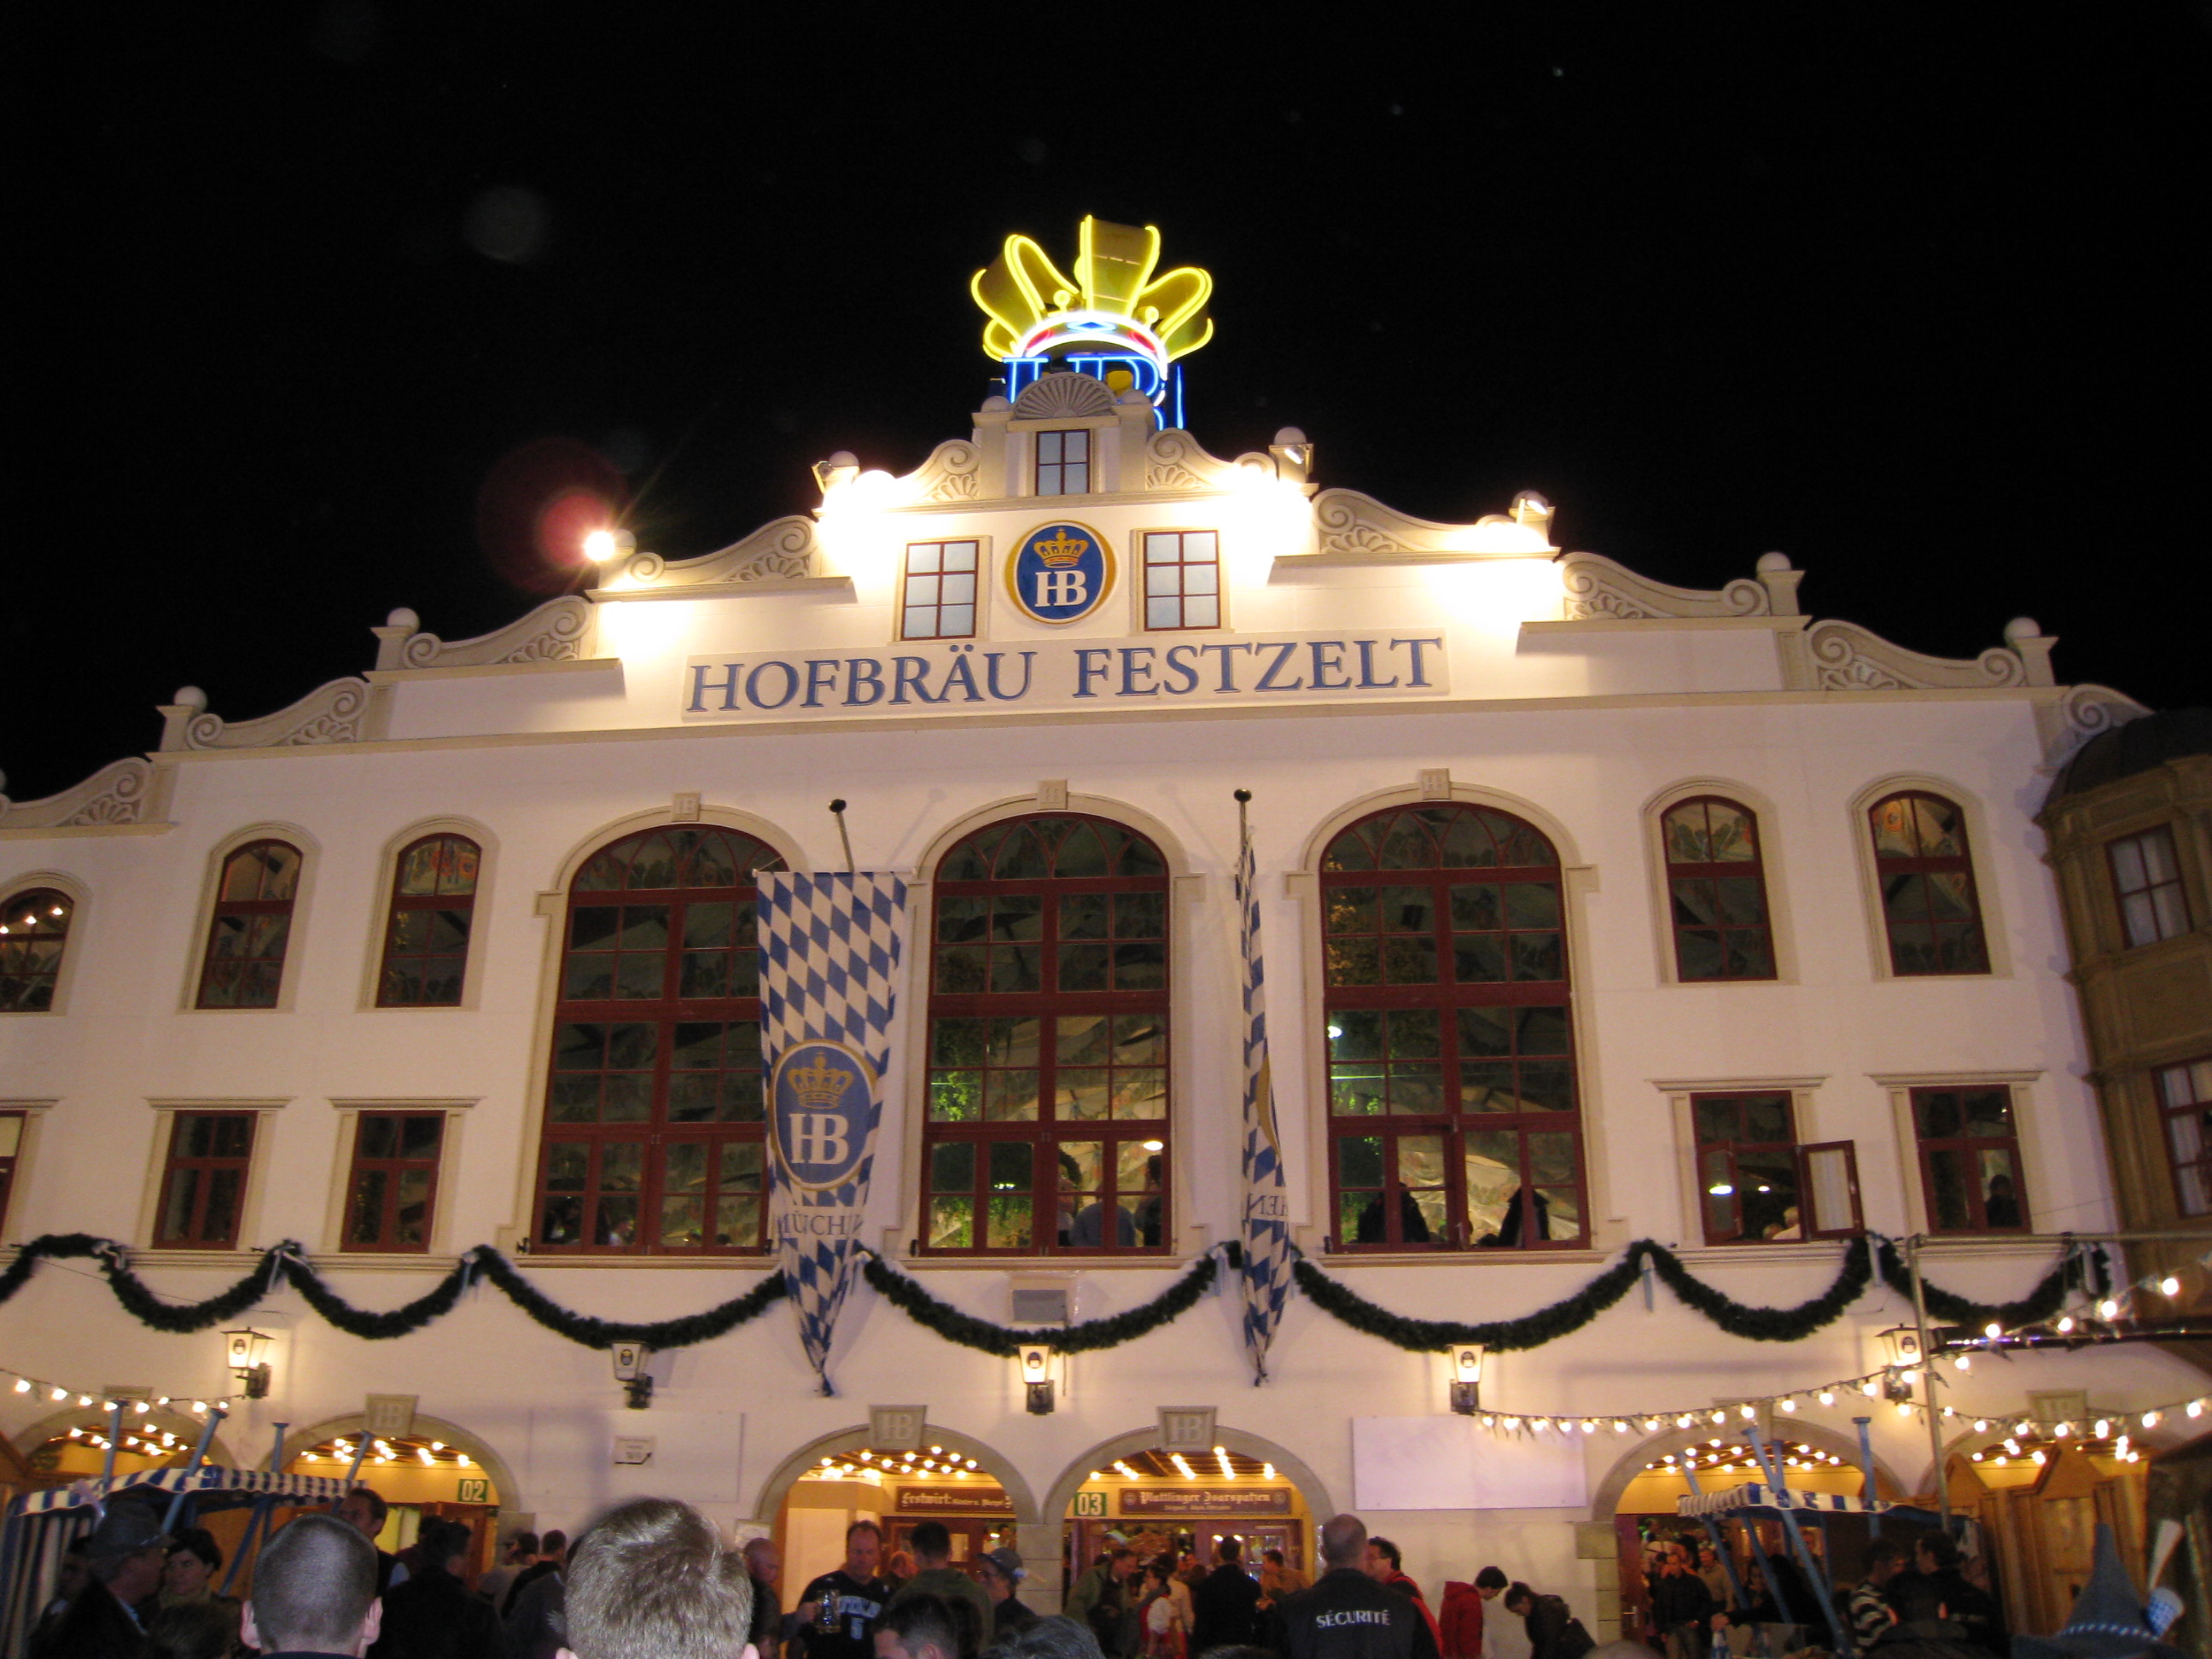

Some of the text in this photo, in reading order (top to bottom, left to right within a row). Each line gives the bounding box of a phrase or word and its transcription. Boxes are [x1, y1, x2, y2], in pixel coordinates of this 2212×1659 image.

[1034, 570, 1088, 607] HB
[686, 637, 1443, 713] HOFBRÄU FESTZELT
[789, 1113, 849, 1165] HB
[462, 1481, 485, 1502] 02
[1078, 1493, 1103, 1516] 03
